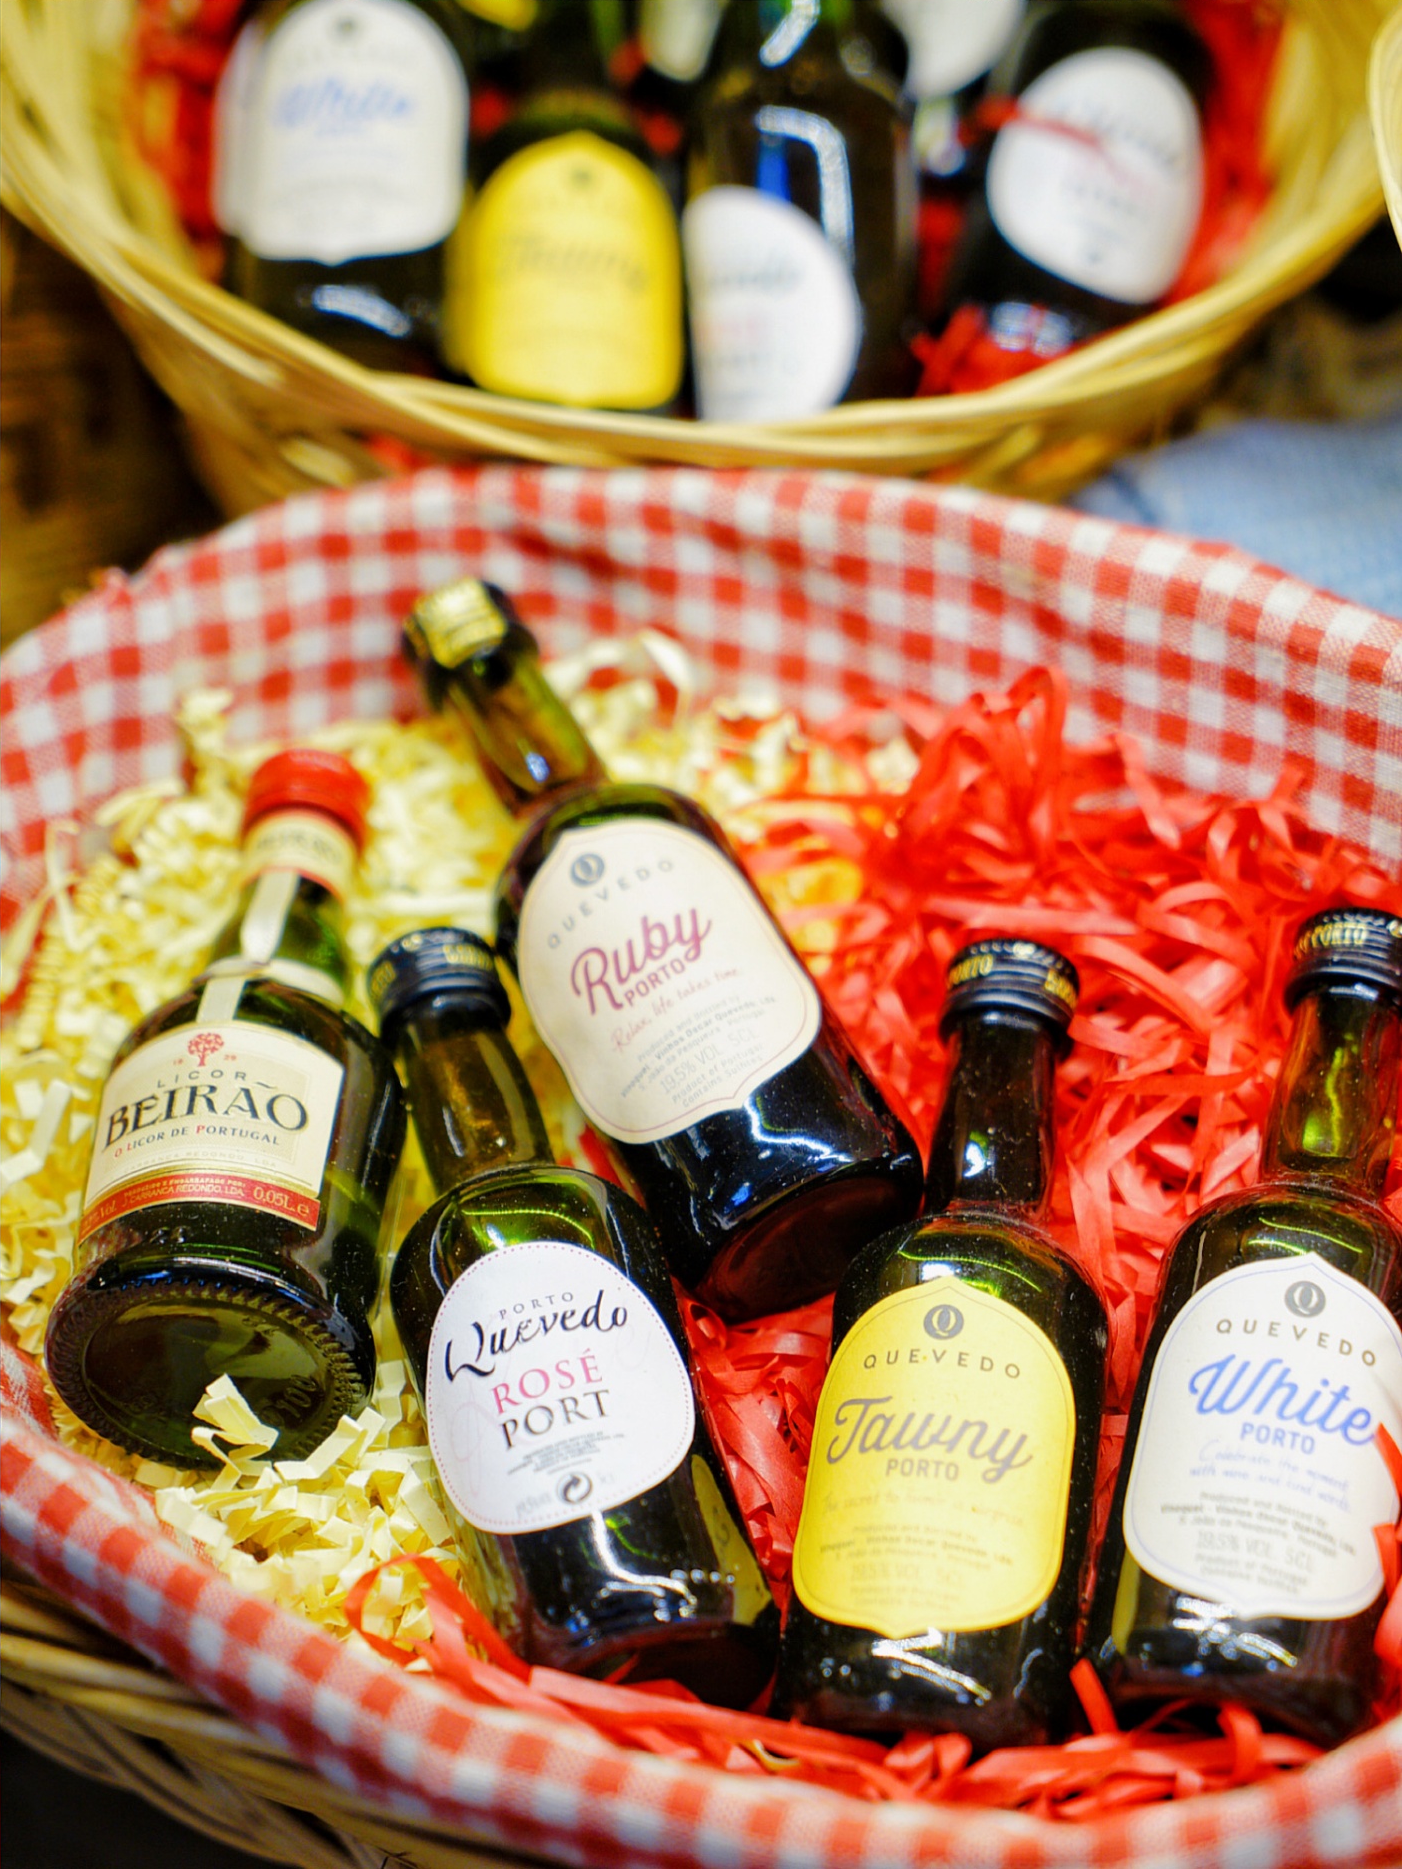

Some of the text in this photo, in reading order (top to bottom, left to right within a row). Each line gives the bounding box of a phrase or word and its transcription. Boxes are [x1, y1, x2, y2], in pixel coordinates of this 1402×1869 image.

[547, 858, 674, 950] QUEVEDO
[570, 907, 712, 1017] Ruby
[623, 956, 686, 1007] PORTO
[157, 1069, 247, 1089] LICOR
[101, 1081, 309, 1153] BEIRÃO
[113, 1124, 281, 1158] O LICOR DE PORTUGAL
[498, 1291, 575, 1321] PORTO
[443, 1288, 628, 1383] Quevedo
[862, 1348, 1021, 1379] QUEVEDO
[1216, 1318, 1378, 1367] QUEVEDO
[490, 1347, 603, 1416] ROSÉ
[1188, 1353, 1377, 1446] White
[500, 1388, 610, 1452] PORT
[826, 1395, 1034, 1484] Tawny
[1239, 1421, 1316, 1456] PORTO
[885, 1457, 960, 1482] PORTO
